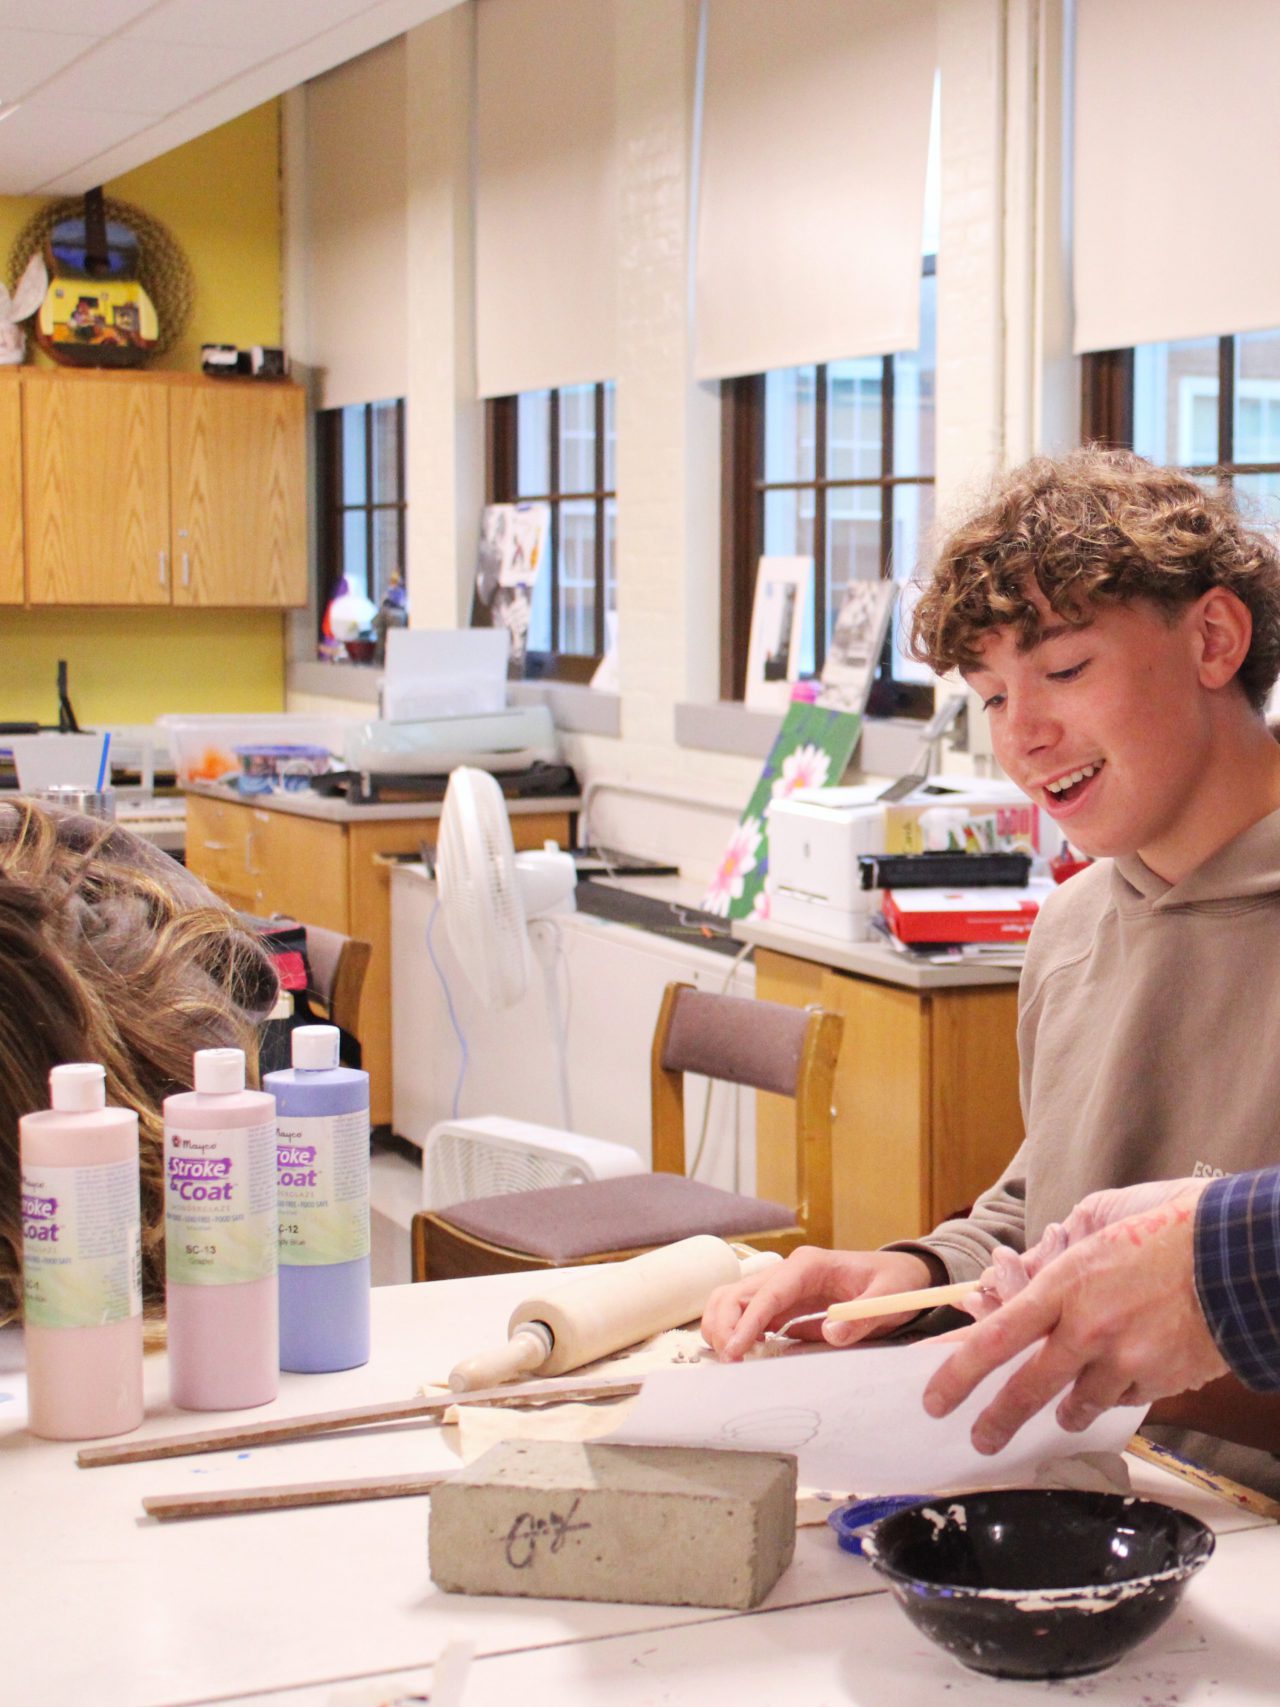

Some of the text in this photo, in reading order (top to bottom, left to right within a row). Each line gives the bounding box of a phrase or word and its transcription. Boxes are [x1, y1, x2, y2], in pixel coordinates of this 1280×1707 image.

[182, 1139, 217, 1155] Mayco
[170, 1158, 226, 1177] Stroke
[180, 1181, 233, 1201] Coat
[278, 1224, 299, 1234] C-12
[185, 1245, 217, 1255] SC-13
